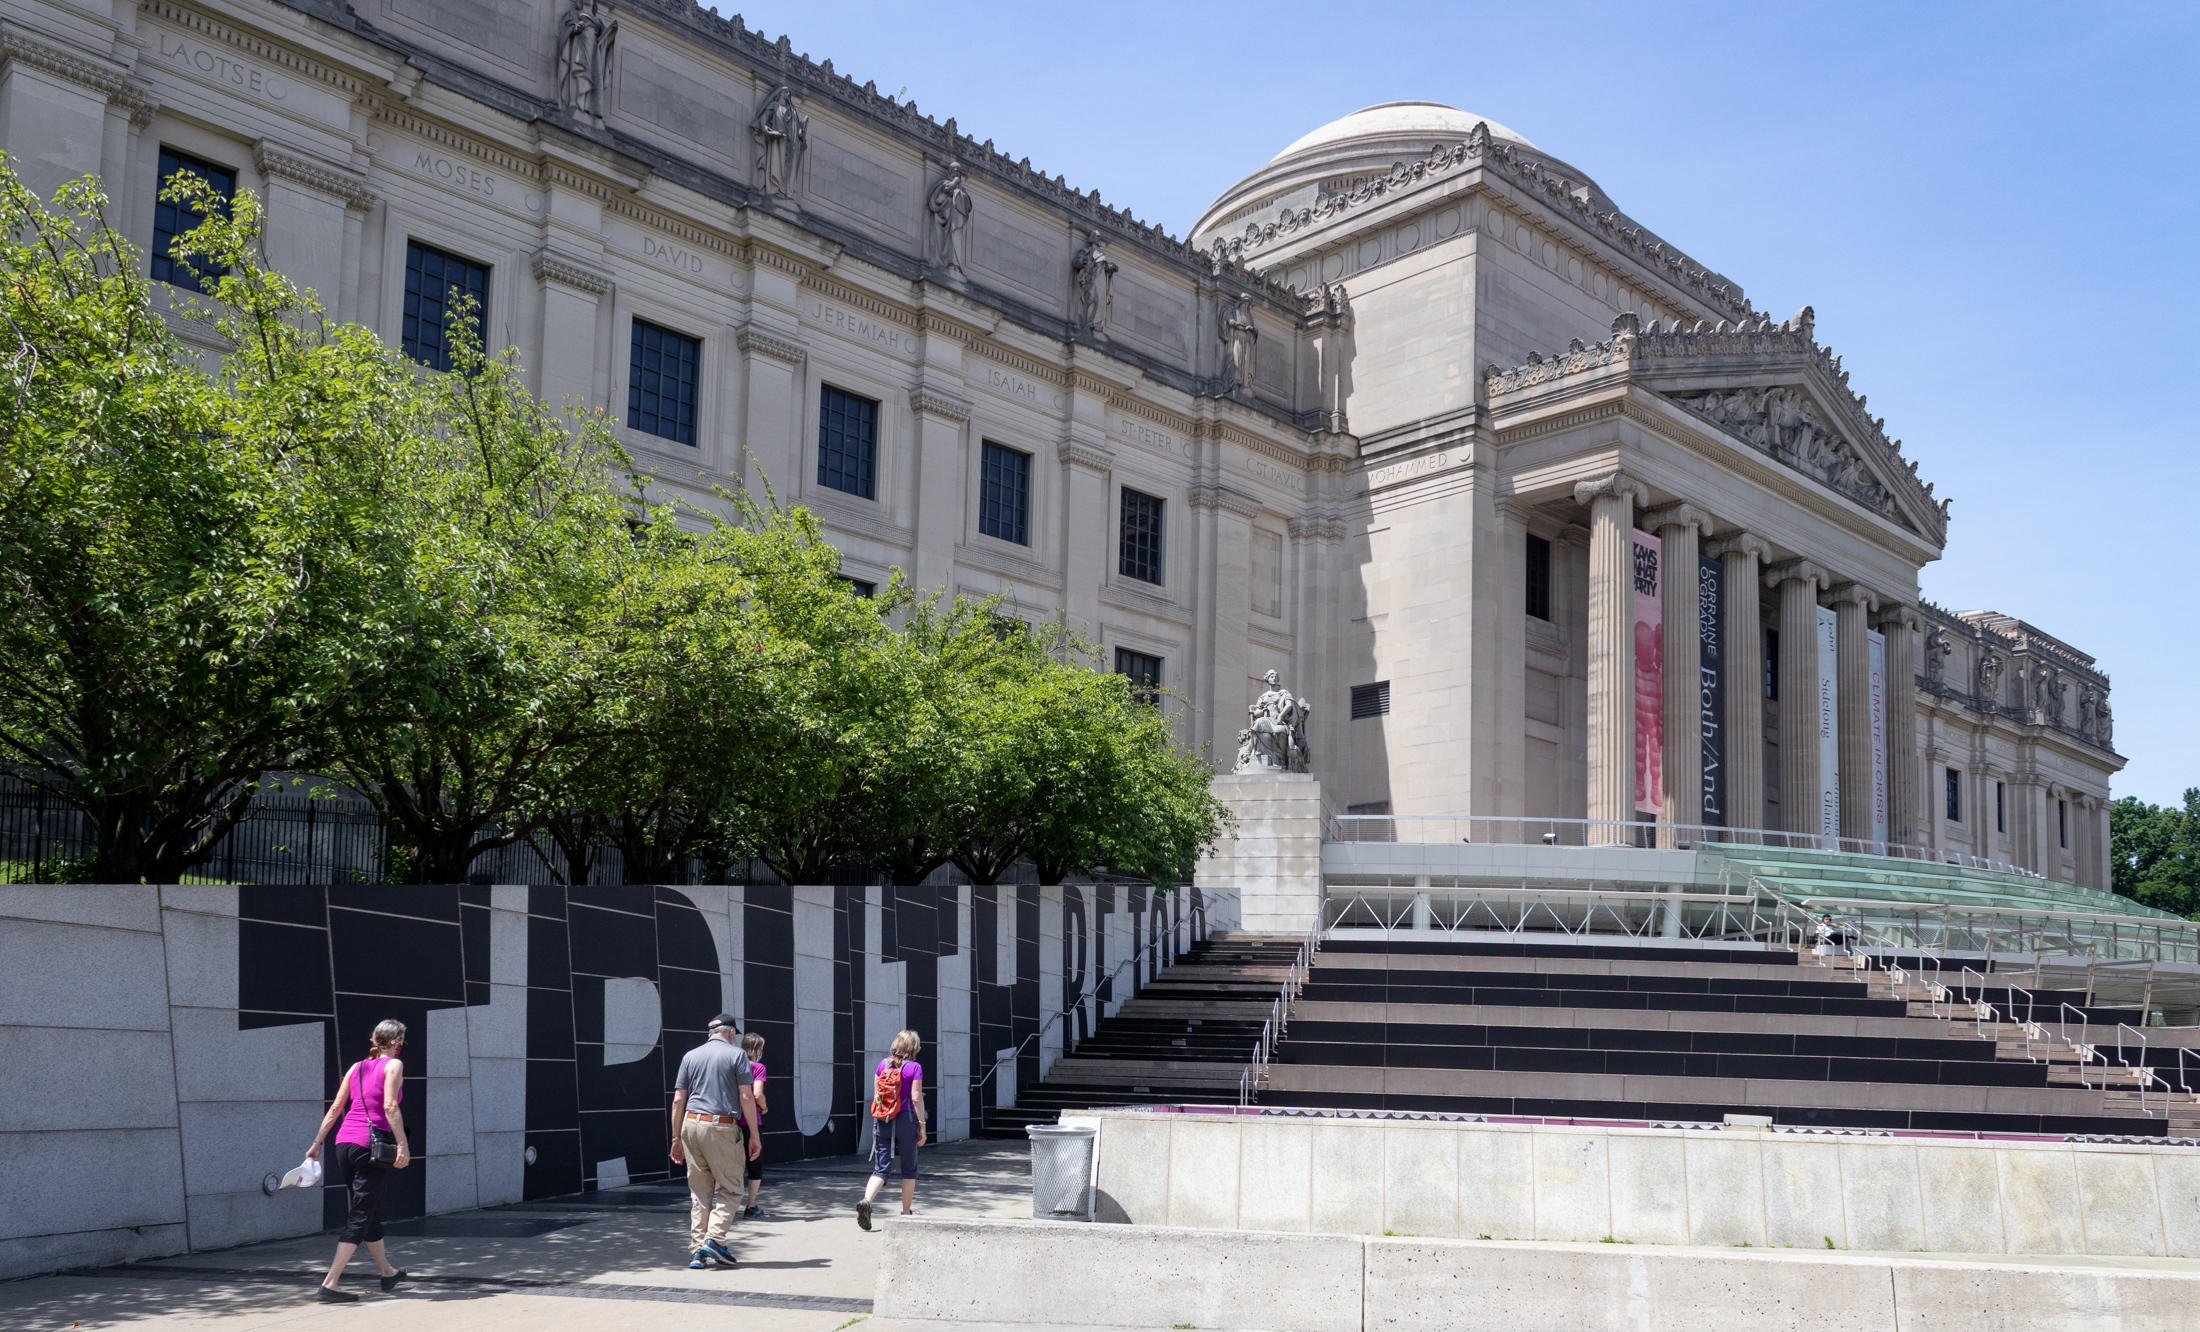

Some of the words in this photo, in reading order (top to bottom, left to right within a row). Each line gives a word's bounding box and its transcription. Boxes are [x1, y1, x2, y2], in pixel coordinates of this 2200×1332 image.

[158, 33, 262, 93] LAOTSE
[414, 151, 495, 196] MOSES
[643, 236, 703, 273] DAVID
[812, 302, 899, 349] JEREMIAH
[988, 369, 1037, 401] ISAIAH
[1364, 453, 1448, 488] MOHAMMED
[1633, 541, 1657, 566] KAWS
[1700, 566, 1709, 644] O'GRADY
[1707, 569, 1717, 656] LORRAINE
[1827, 617, 1835, 652] John
[1820, 677, 1831, 739] Sidelong
[1872, 672, 1881, 744] CLIMATE
[1700, 666, 1721, 815] Both/And
[1874, 748, 1882, 765] IN
[1875, 769, 1884, 824] CRISIS
[239, 885, 1040, 1232] TRUTH
[1128, 886, 1206, 1000] TO
